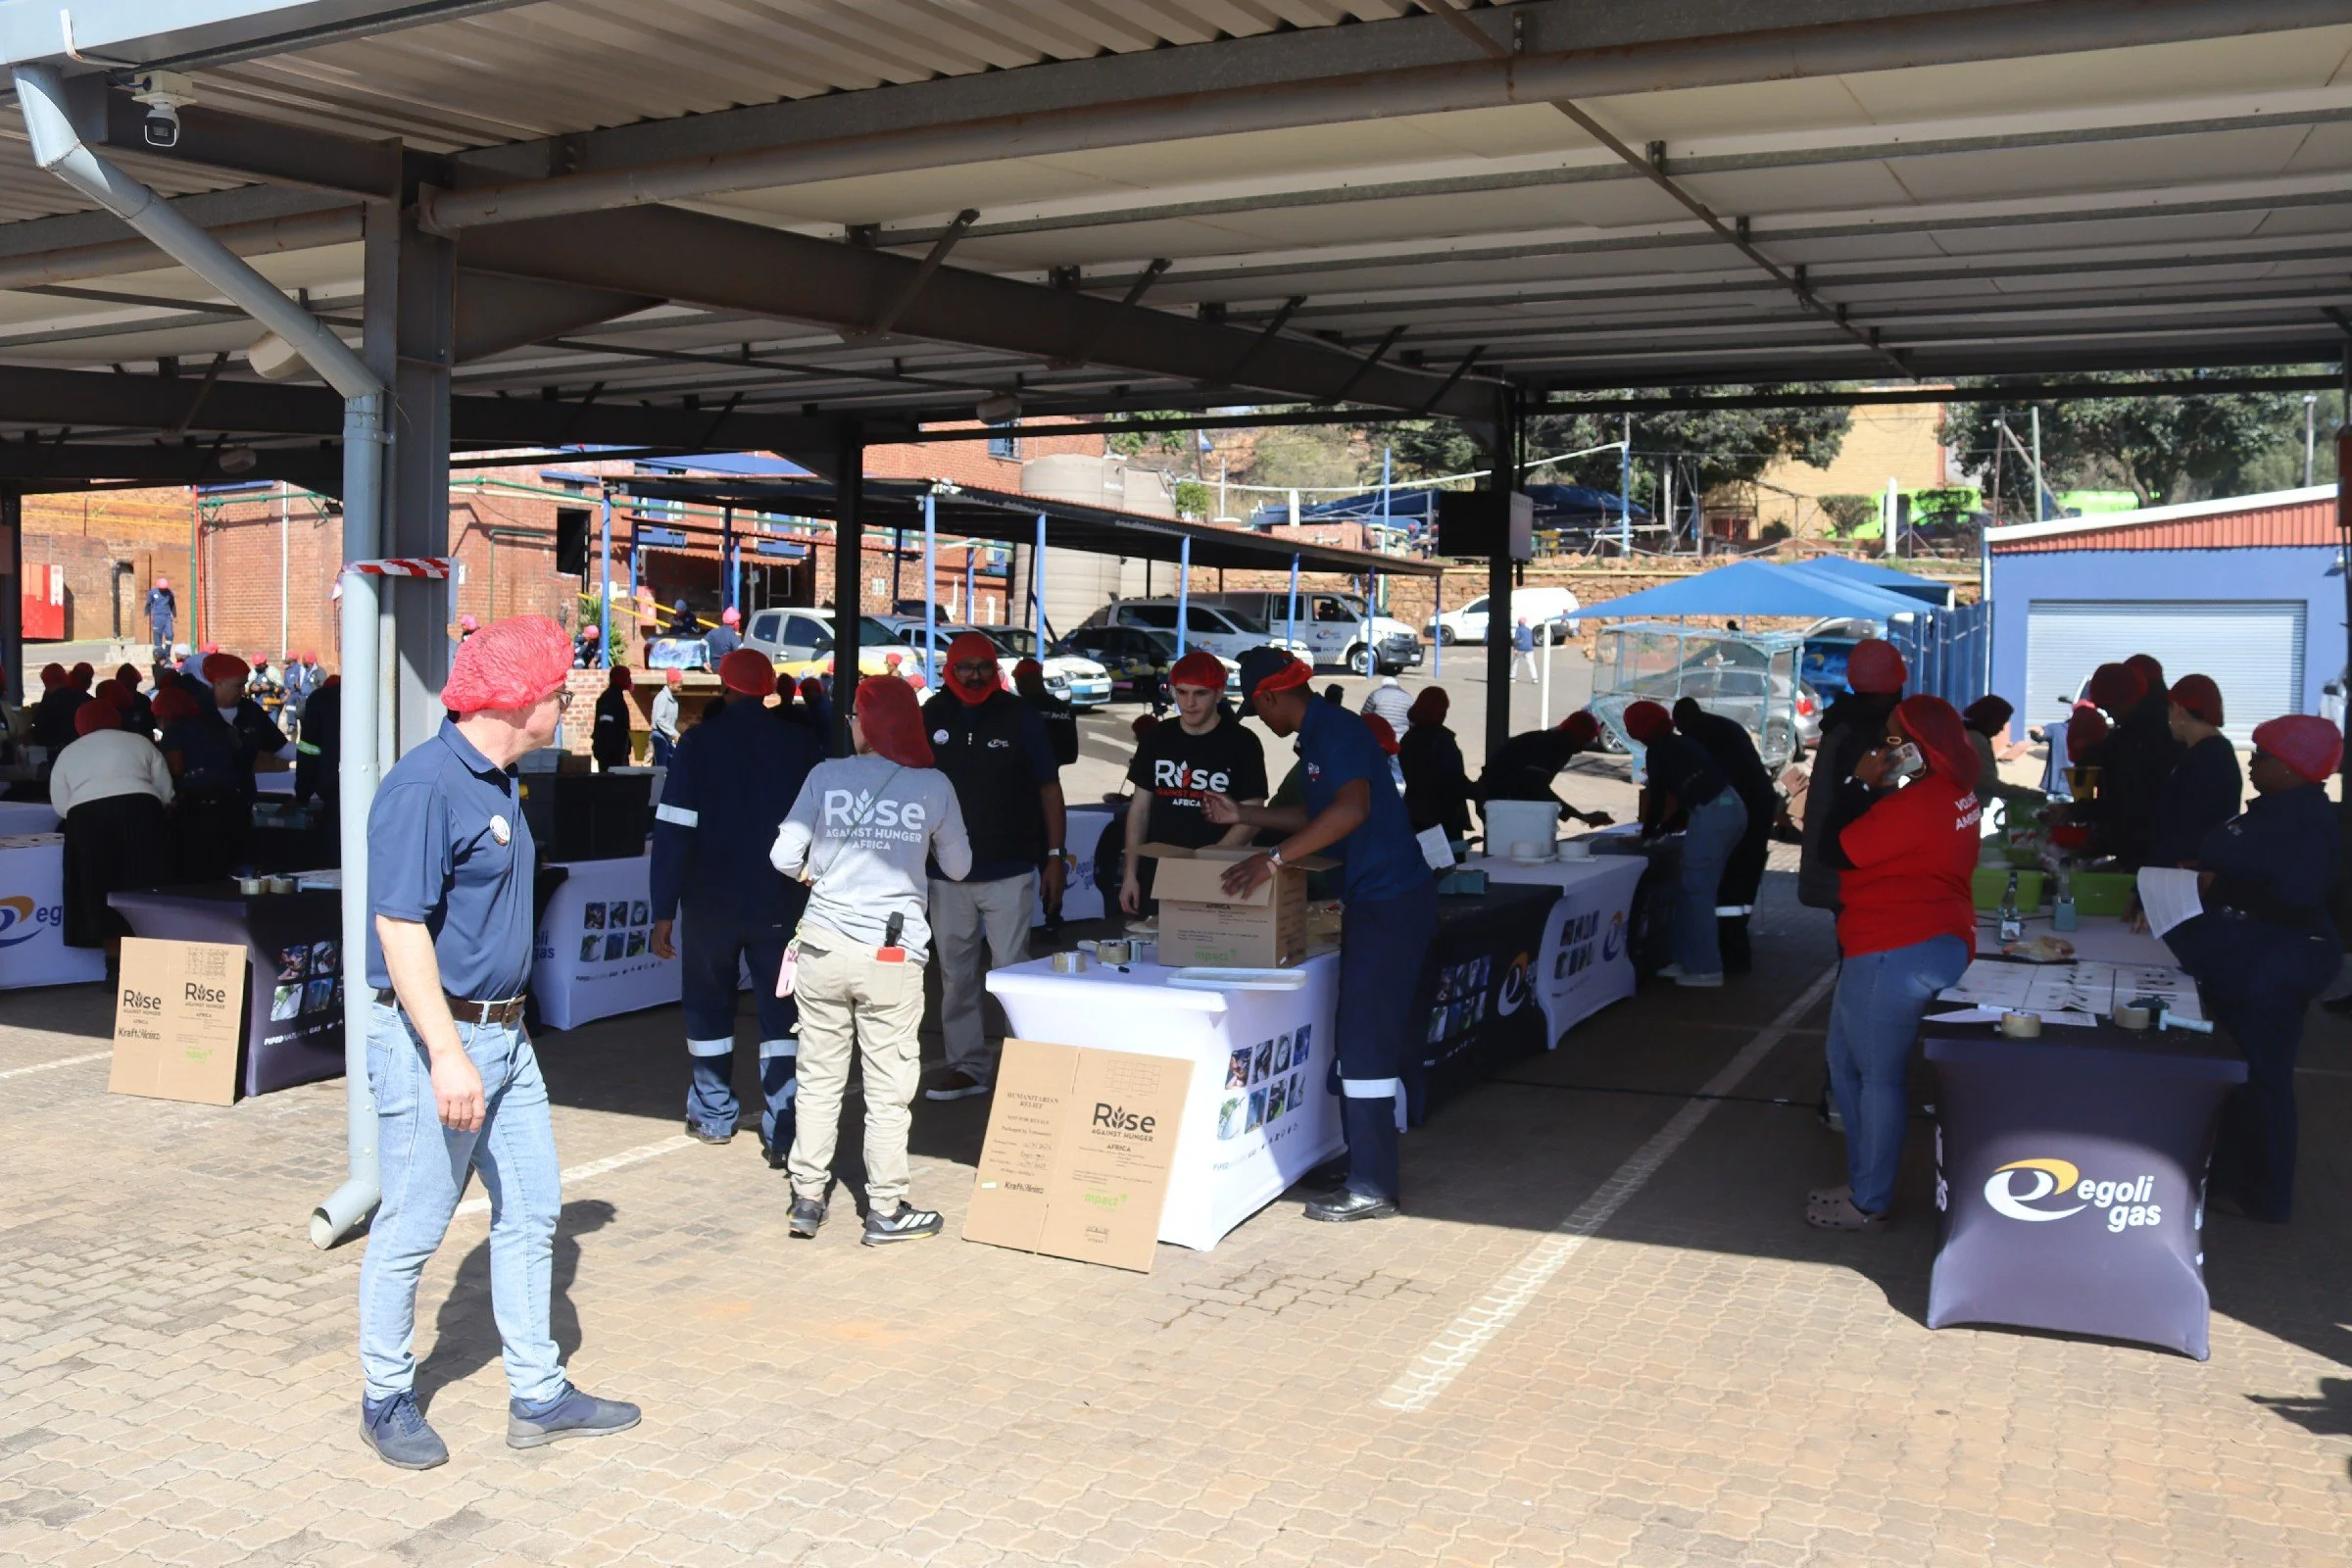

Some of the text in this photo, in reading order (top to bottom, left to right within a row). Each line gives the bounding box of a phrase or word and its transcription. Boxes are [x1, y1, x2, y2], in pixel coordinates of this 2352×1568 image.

[1154, 759, 1230, 793] Rise
[824, 788, 926, 830] Rise
[1172, 798, 1201, 808] AFRICA
[825, 827, 922, 843] AGAINST HUNGER
[852, 840, 891, 851] AFRICA
[35, 905, 63, 927] eg
[123, 989, 162, 1010] Rise
[185, 982, 225, 1003] Rise
[1006, 1092, 1059, 1104] HUMANITARIAN
[1019, 1102, 1044, 1110] RELIEF
[1092, 1102, 1155, 1134] Rise
[1091, 1128, 1153, 1142] AGAINST HUNGER
[1106, 1144, 1131, 1152] AFRICA
[2077, 1175, 2155, 1208] egoli
[2107, 1204, 2162, 1233] gas
